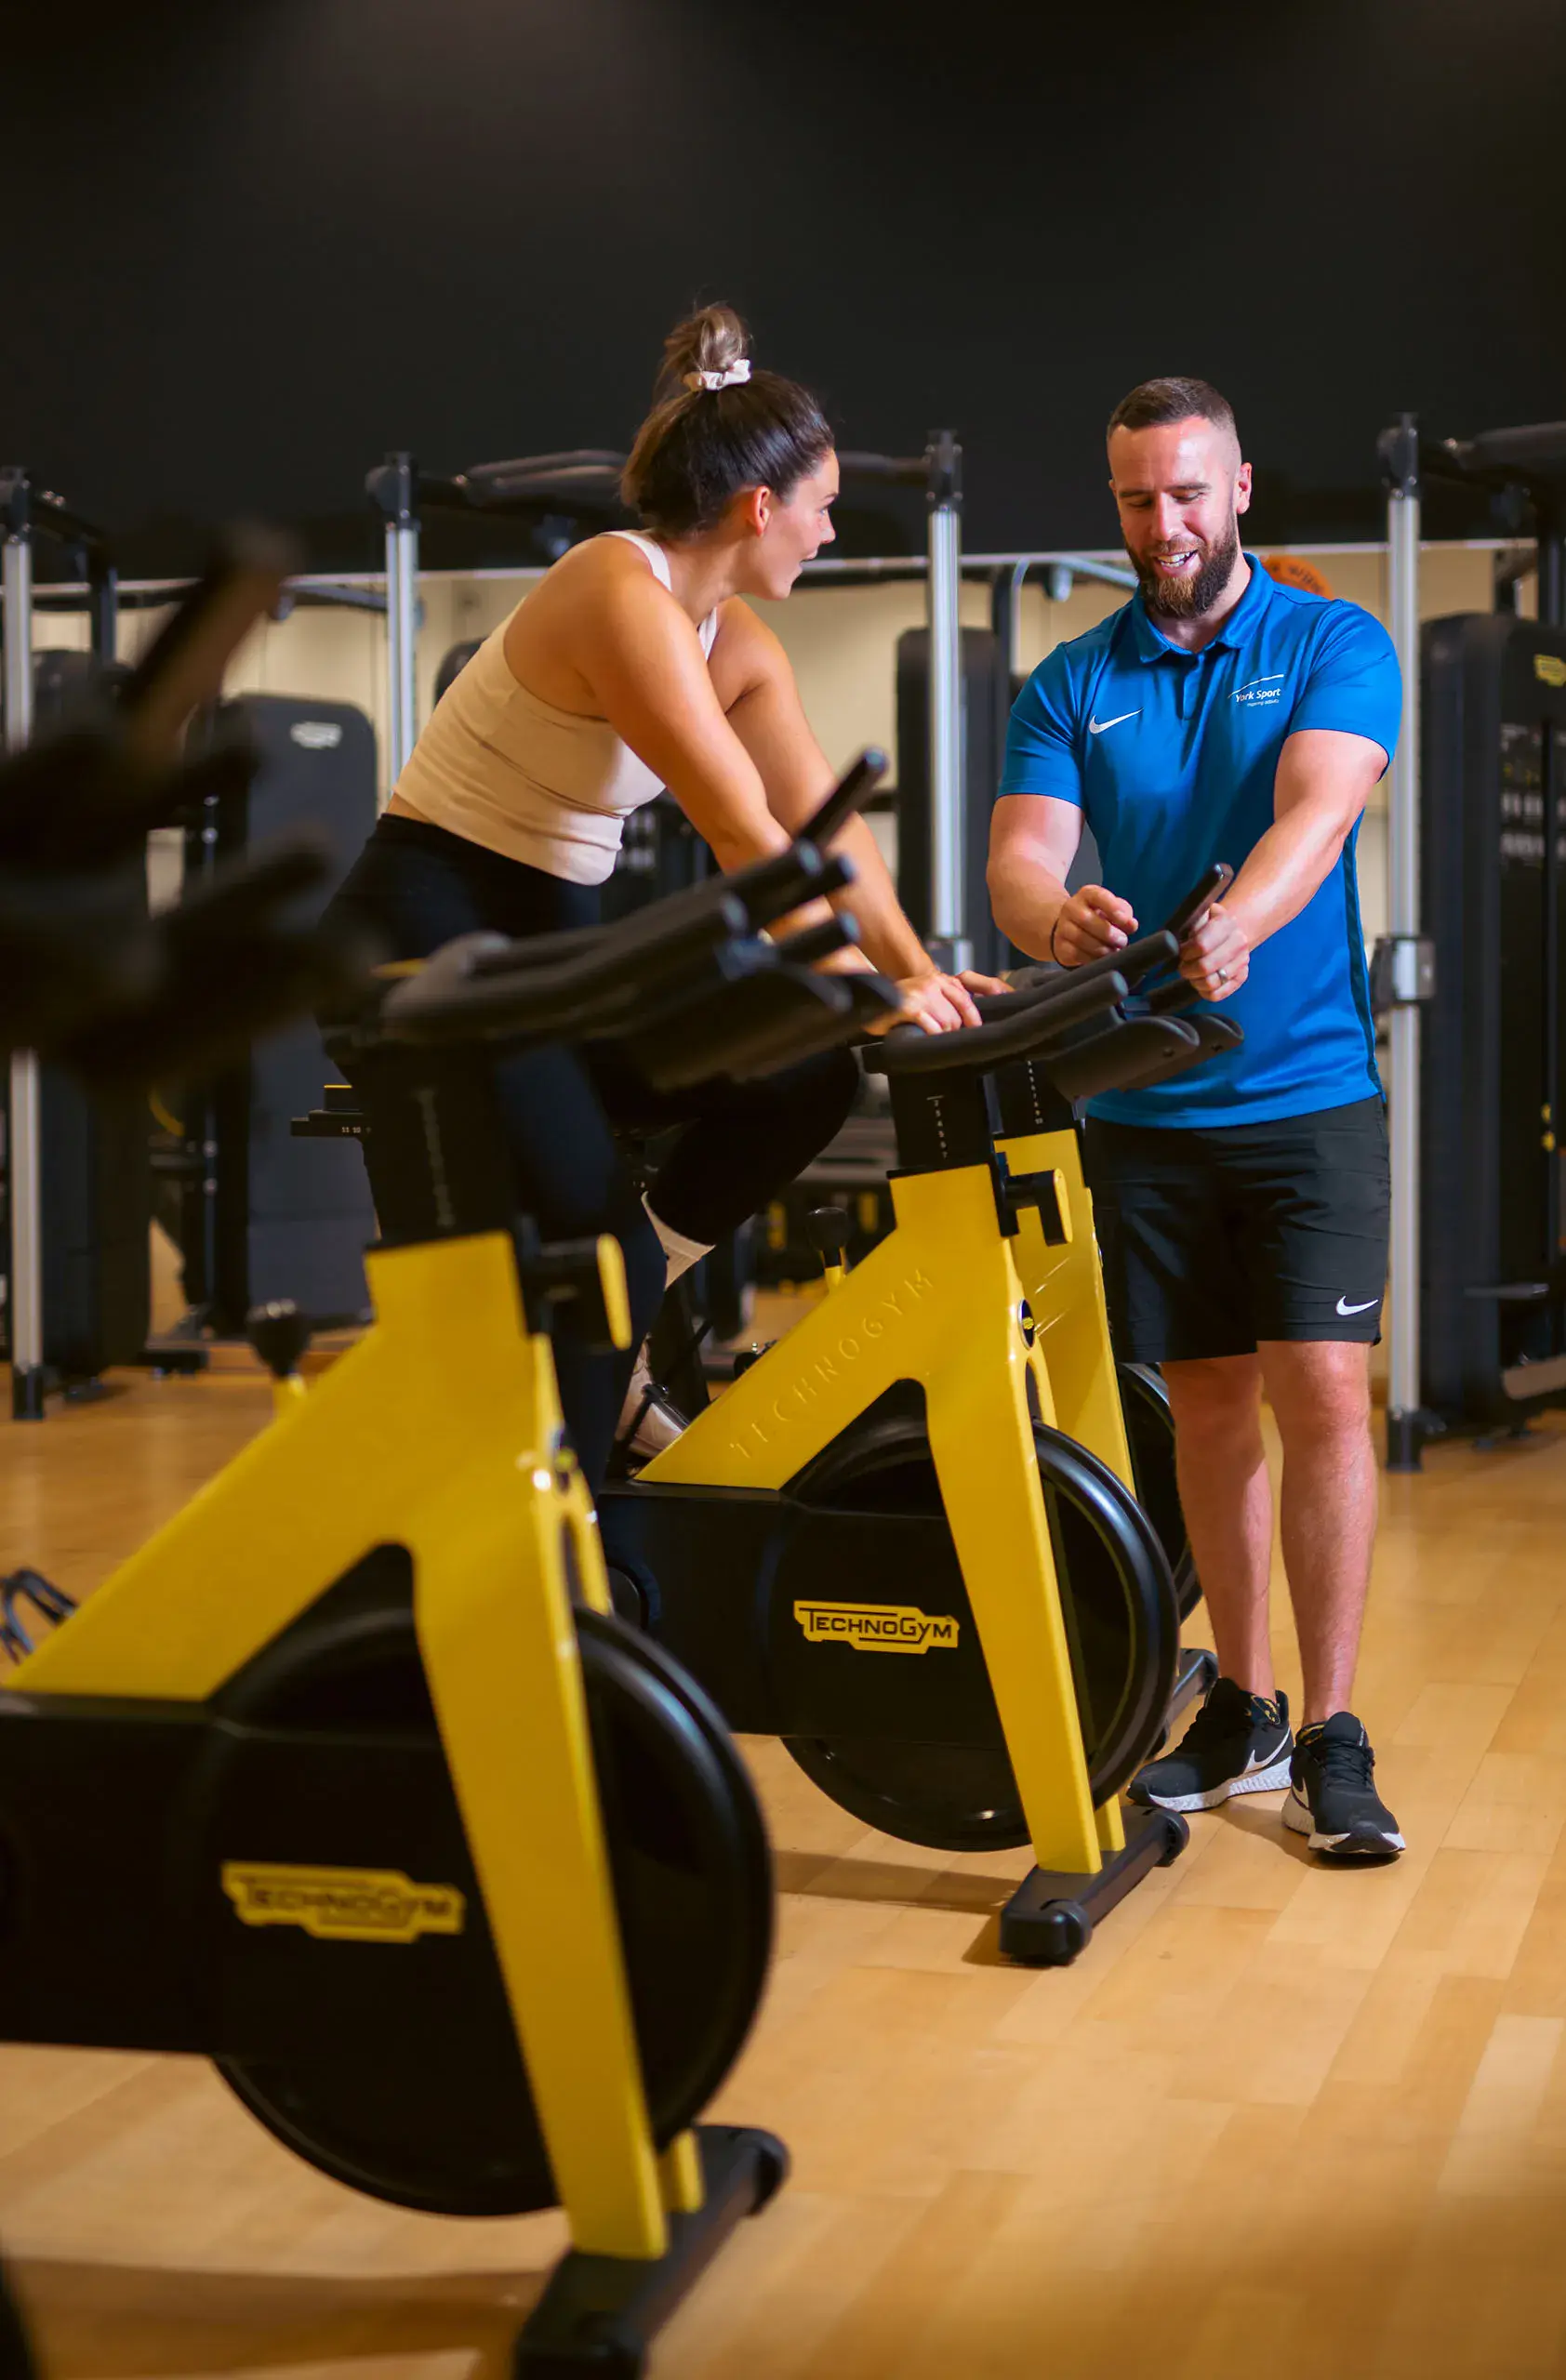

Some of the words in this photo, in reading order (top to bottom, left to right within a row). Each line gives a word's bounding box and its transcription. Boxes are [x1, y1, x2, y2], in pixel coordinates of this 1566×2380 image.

[1235, 691, 1254, 703] York
[1255, 688, 1281, 700] Sport
[729, 1270, 934, 1459] TECHNOGYM
